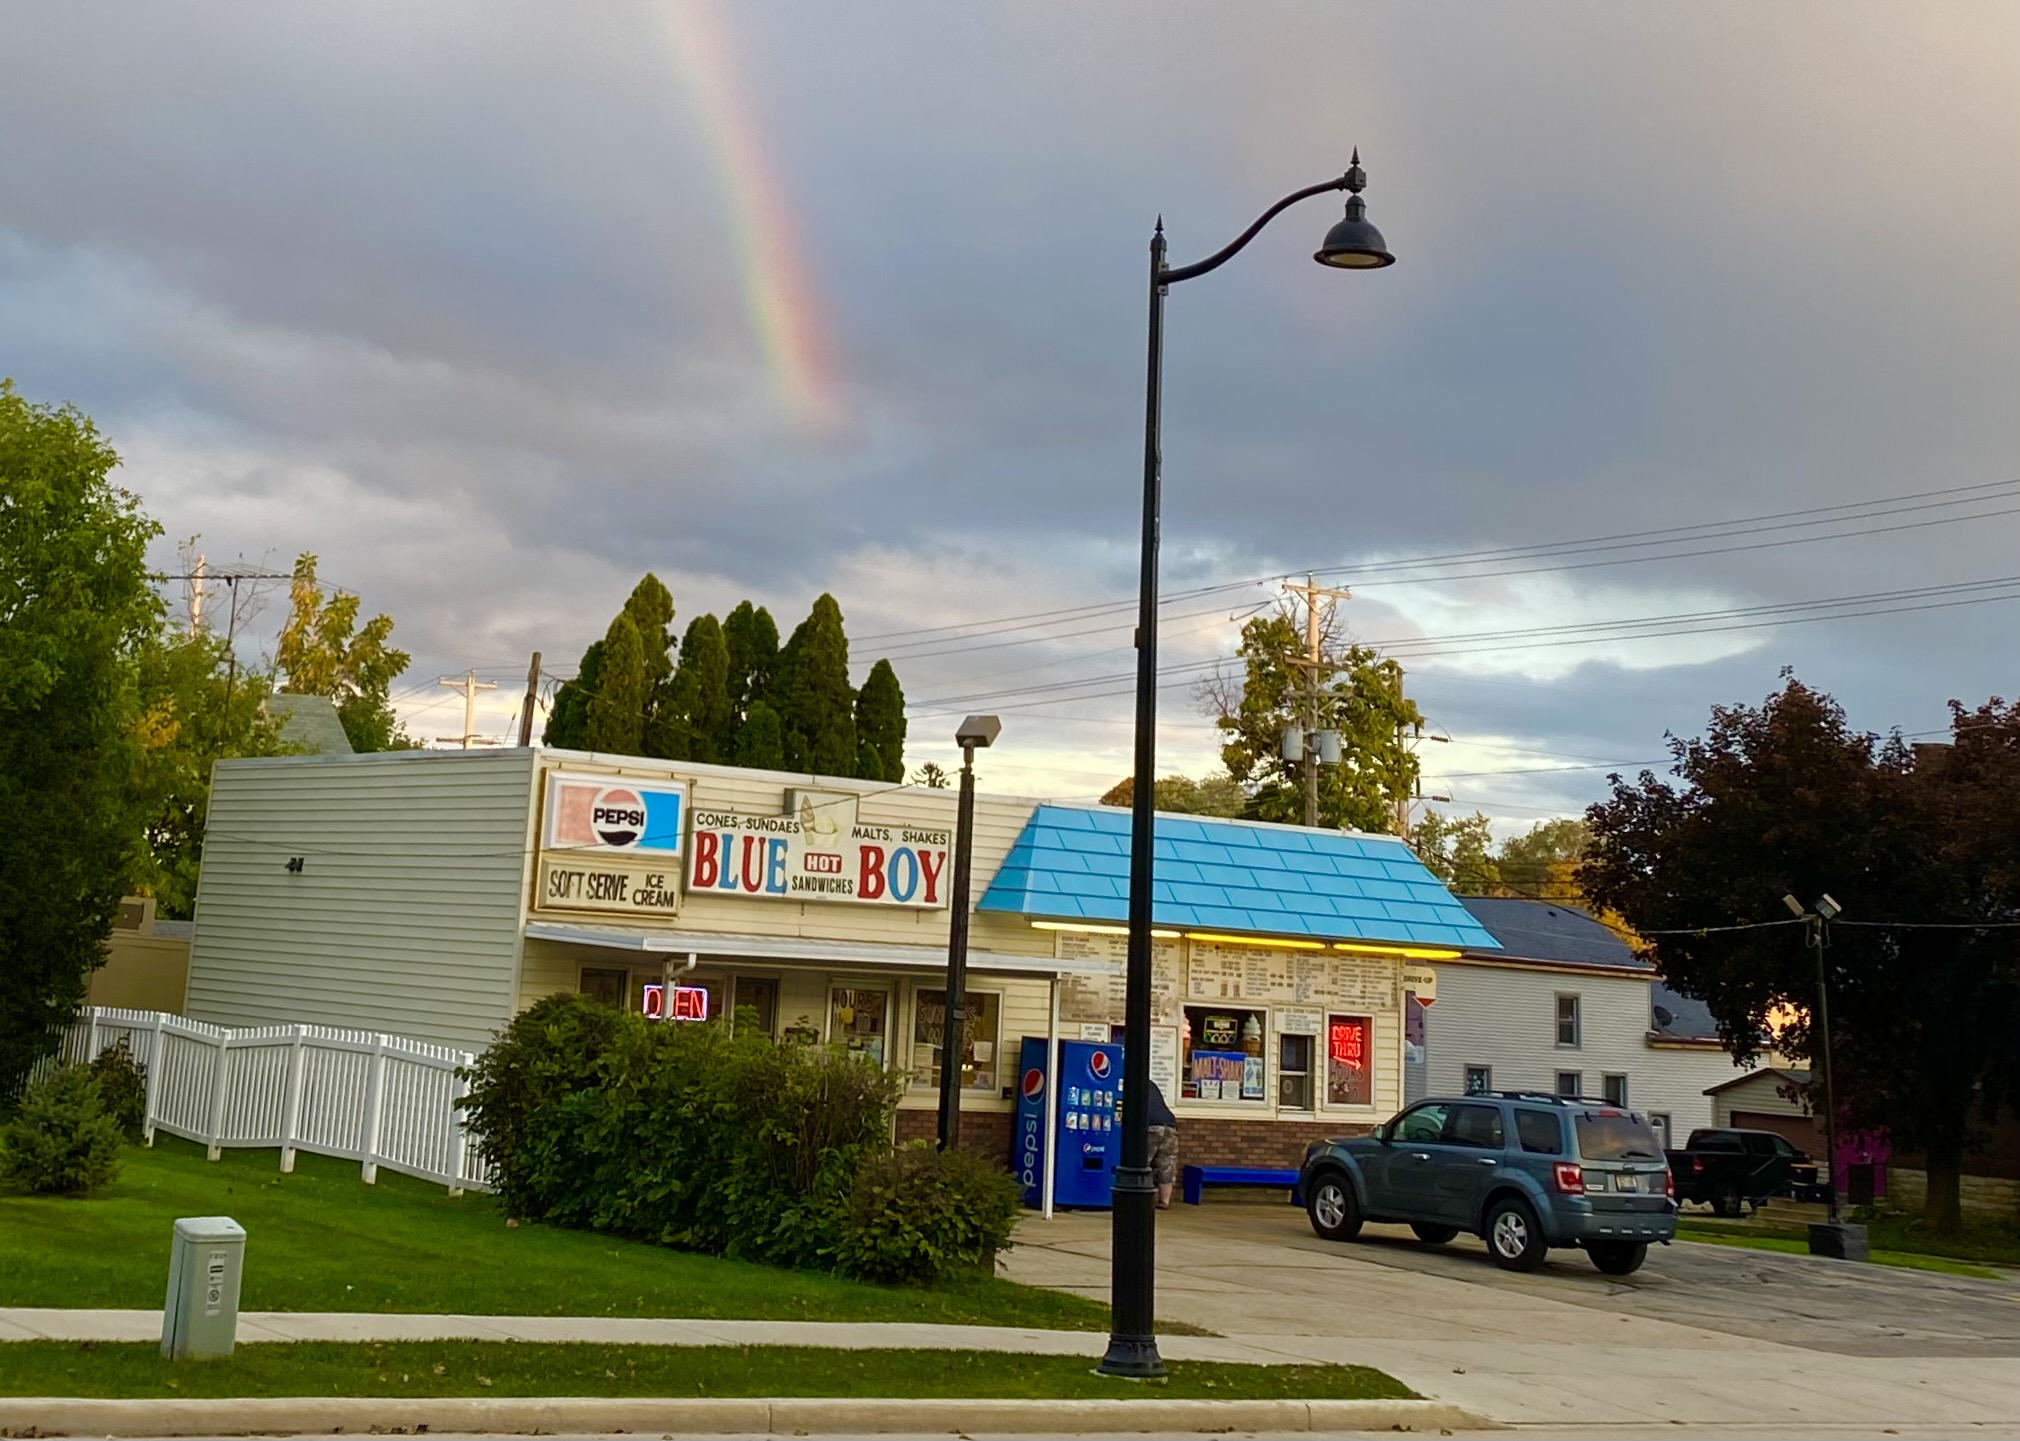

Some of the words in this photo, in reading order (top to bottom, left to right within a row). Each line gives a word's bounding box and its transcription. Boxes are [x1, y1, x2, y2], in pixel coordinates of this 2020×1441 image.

[592, 807, 645, 827] PEPSI
[696, 812, 742, 830] CONES,
[745, 817, 800, 834] SUNDAES
[851, 826, 894, 843] MALTS,
[902, 830, 947, 845] SHAKES
[692, 831, 788, 894] BLUE
[857, 845, 946, 903] BOY
[806, 854, 840, 872] HOT
[548, 869, 585, 899] SOFT
[585, 872, 629, 902] SERVE
[645, 874, 665, 889] ICE
[791, 875, 853, 895] SANDWICHES
[632, 889, 675, 908] CREAM
[647, 989, 703, 1019] OEN
[1332, 1026, 1362, 1042] DRIVE
[1333, 1042, 1361, 1058] THRU
[1022, 1111, 1039, 1188] pepsi
